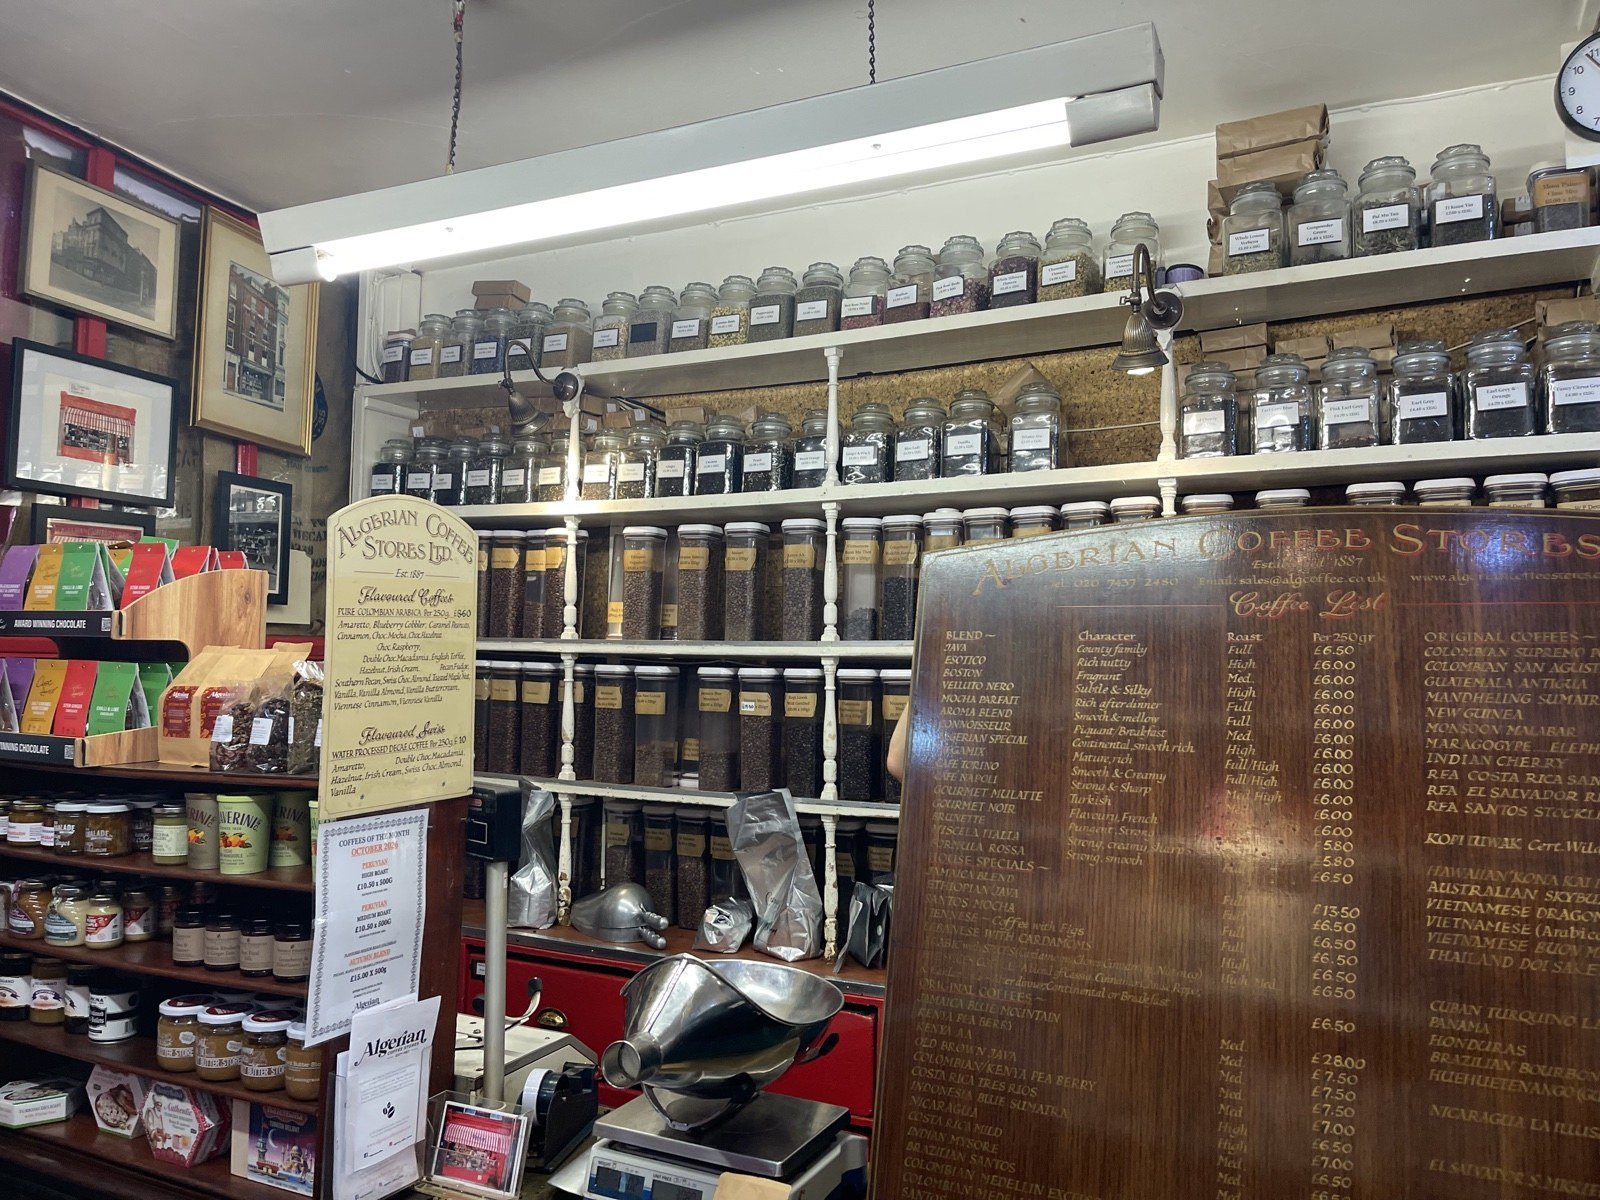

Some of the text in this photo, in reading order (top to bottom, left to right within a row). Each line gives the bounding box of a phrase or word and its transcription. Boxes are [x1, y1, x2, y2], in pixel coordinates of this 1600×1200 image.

[1573, 65, 1584, 75] 10
[1568, 86, 1576, 96] 9
[1576, 105, 1584, 115] 8
[338, 509, 418, 560] ALGERIAN
[426, 513, 472, 564] COFFEE
[362, 535, 454, 565] STORES LTD.
[972, 538, 1176, 596] ALGERIAN
[1200, 529, 1371, 560] COFFEE
[410, 570, 424, 580] 1887
[358, 586, 417, 606] Flavoured
[1229, 589, 1386, 619] Coffee List
[338, 608, 422, 617] PURE COLOMBIAN ARABICA
[14, 620, 86, 629] AWARD WINNING CHOCOLATE
[372, 620, 403, 630] Blueberry
[946, 631, 983, 640] BLEND
[1078, 630, 1137, 641] Character
[1226, 632, 1263, 641] Roast
[1312, 632, 1331, 642] Per
[1424, 632, 1580, 643] ORIGINAL COFFEES
[944, 643, 968, 652] JAVA
[1077, 643, 1148, 657] County family
[1228, 645, 1253, 655] Full
[1313, 644, 1354, 656] £6.50
[1424, 646, 1585, 658] COLOMBIAN SUPREMO
[362, 652, 449, 662] Double English
[944, 656, 986, 665] ESOTICO
[1077, 656, 1132, 672] Rich nutty
[1227, 660, 1257, 672] High
[1313, 660, 1356, 671] £6.00
[1424, 660, 1546, 673] COLOMBIAN SAN
[943, 668, 983, 678] BOSTON
[1076, 670, 1122, 684] Fragrant
[335, 678, 366, 688] Southern
[942, 680, 1014, 692] VELLUTO NERO
[1424, 676, 1589, 690] GUATEMALA ANTIGUA
[359, 686, 425, 698] Vanilla Vanilla
[1074, 684, 1152, 698] Subtle & Silky
[1226, 687, 1257, 701] High
[1426, 692, 1532, 704] MANDHELING
[334, 694, 443, 710] Viennese Viennese Vanilla
[941, 694, 1021, 706] MOCHA PARFAIT
[940, 706, 1013, 718] AROMA BLEND
[1074, 711, 1160, 725] Smooth mellow
[1426, 707, 1523, 721] NEW GUINEA
[358, 724, 417, 746] Flavoured
[1072, 724, 1167, 739] Piquant/Breakfast
[989, 734, 1028, 746] SPECIAL
[19, 742, 50, 754] CHOCOLATE
[332, 740, 428, 760] WATER PROCESSED DECAF COFFEE
[395, 756, 416, 766] Double
[1112, 752, 1133, 764] rich
[1426, 753, 1567, 768] INDIAN CHERRY
[365, 765, 420, 780] Irish Swiss
[1124, 768, 1167, 784] Creamy
[1313, 762, 1354, 776] £6.00
[1426, 769, 1563, 784] RFA COSTA RICA
[330, 784, 356, 797] Vanilla
[933, 785, 1044, 802] GOURMET MULATTE
[1490, 786, 1578, 801] SALVADOR
[932, 798, 1016, 814] GOURMET NOIR
[1069, 794, 1112, 806] Turkish
[338, 835, 375, 848] COFFEES OF
[1424, 832, 1464, 846] KOPI
[351, 844, 383, 856] OCTOBER
[362, 858, 388, 870] PERUVIAN
[976, 856, 1035, 872] SPECIALS
[374, 868, 388, 876] ROAST
[1312, 872, 1354, 886] £6.50
[356, 880, 375, 890] £10.50
[380, 876, 393, 885] 500G
[1428, 880, 1539, 900] AUSTRALIAN
[362, 900, 388, 912] PERUVIAN
[1426, 898, 1531, 918] VIETNAMESE
[356, 908, 392, 922] MEDIUM ROAST
[355, 923, 374, 933] £10.50
[378, 918, 392, 927] 500G
[1312, 920, 1356, 934] £6.50
[1426, 916, 1532, 935] VIETNAMESE
[350, 955, 373, 966] AUTUMN
[373, 948, 391, 958] BLEND
[350, 971, 368, 982] £15.00
[1430, 1000, 1483, 1016] CUBAN
[1312, 1017, 1356, 1033] £6.50
[354, 1029, 428, 1066] Algerian
[1428, 1034, 1528, 1057] HONDURAS
[1312, 1069, 1358, 1086] £7.50
[1312, 1120, 1356, 1136] £7.00
